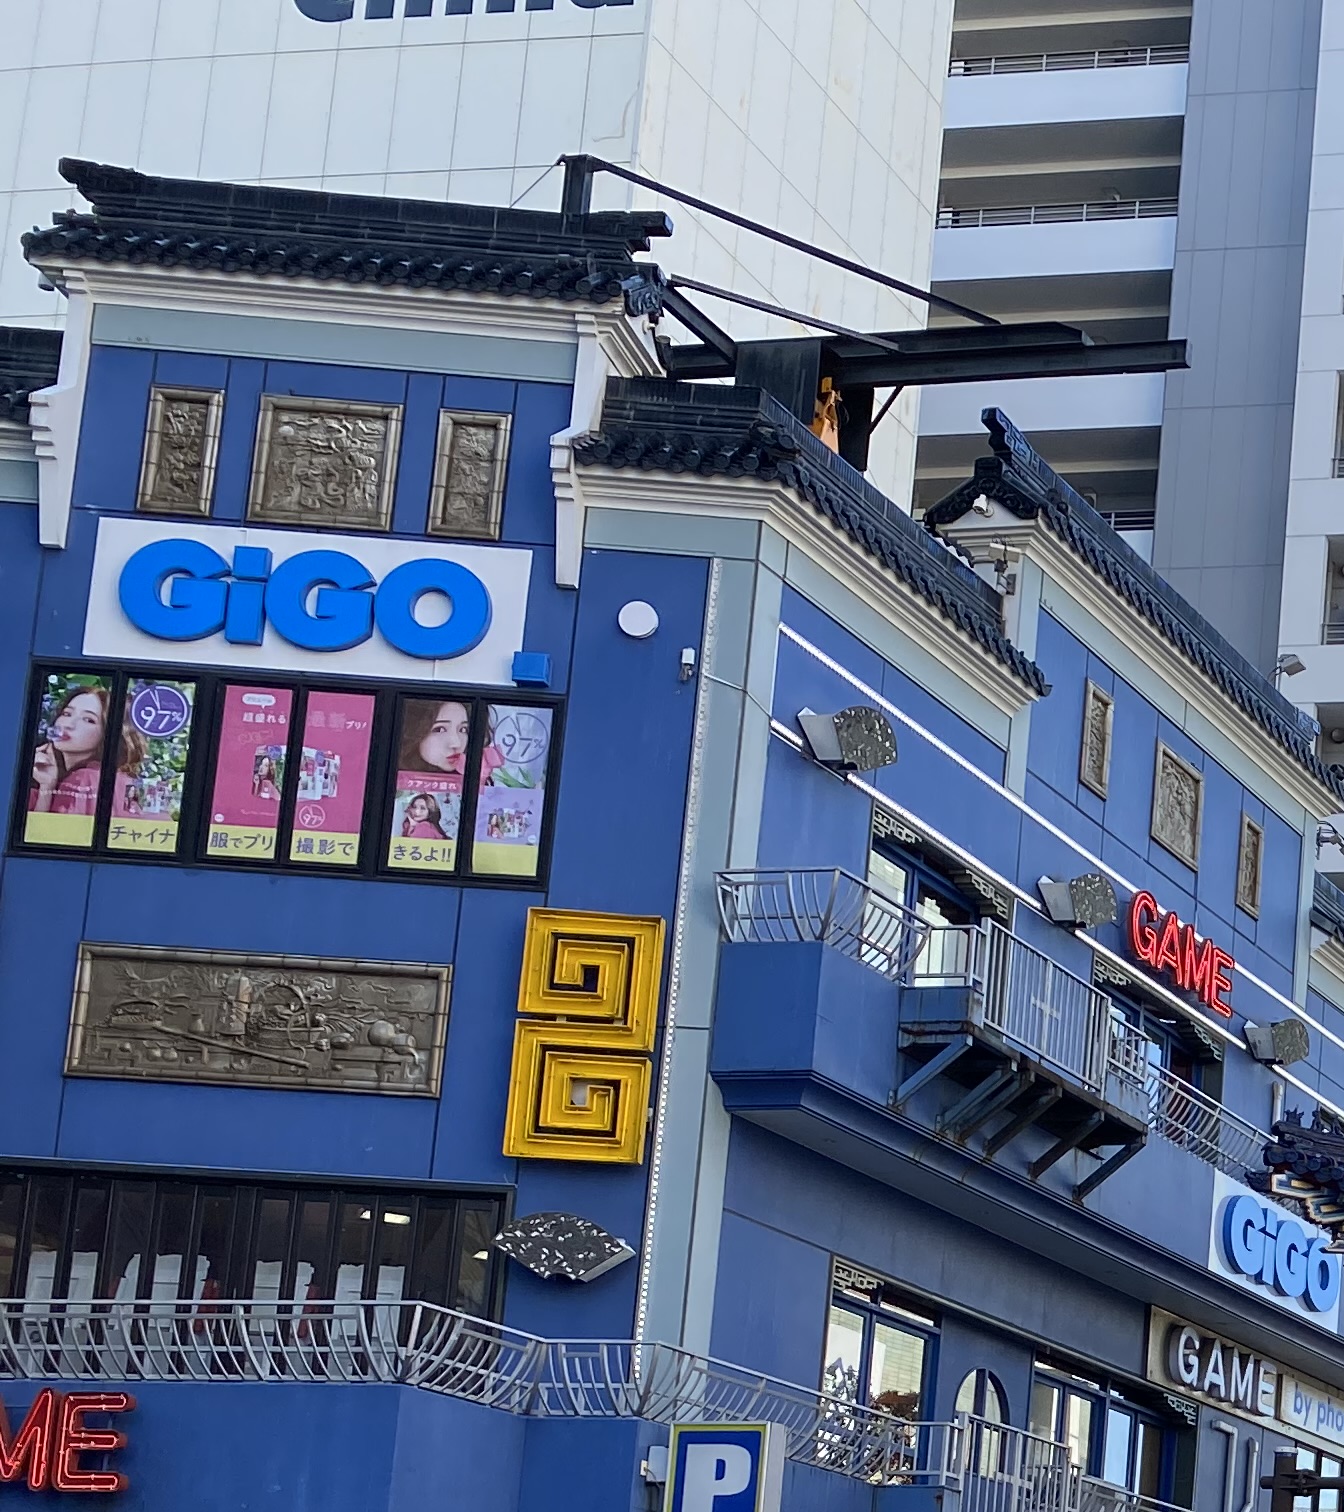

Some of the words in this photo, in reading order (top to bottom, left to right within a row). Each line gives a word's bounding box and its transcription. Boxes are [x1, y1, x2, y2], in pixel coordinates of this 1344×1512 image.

[109, 825, 175, 845] チャイナ
[209, 831, 274, 851] 服でプリ
[295, 836, 354, 856] 撮影で
[1128, 890, 1236, 1018] GAME
[1168, 1322, 1277, 1418] GAME
[1293, 1381, 1312, 1427] by
